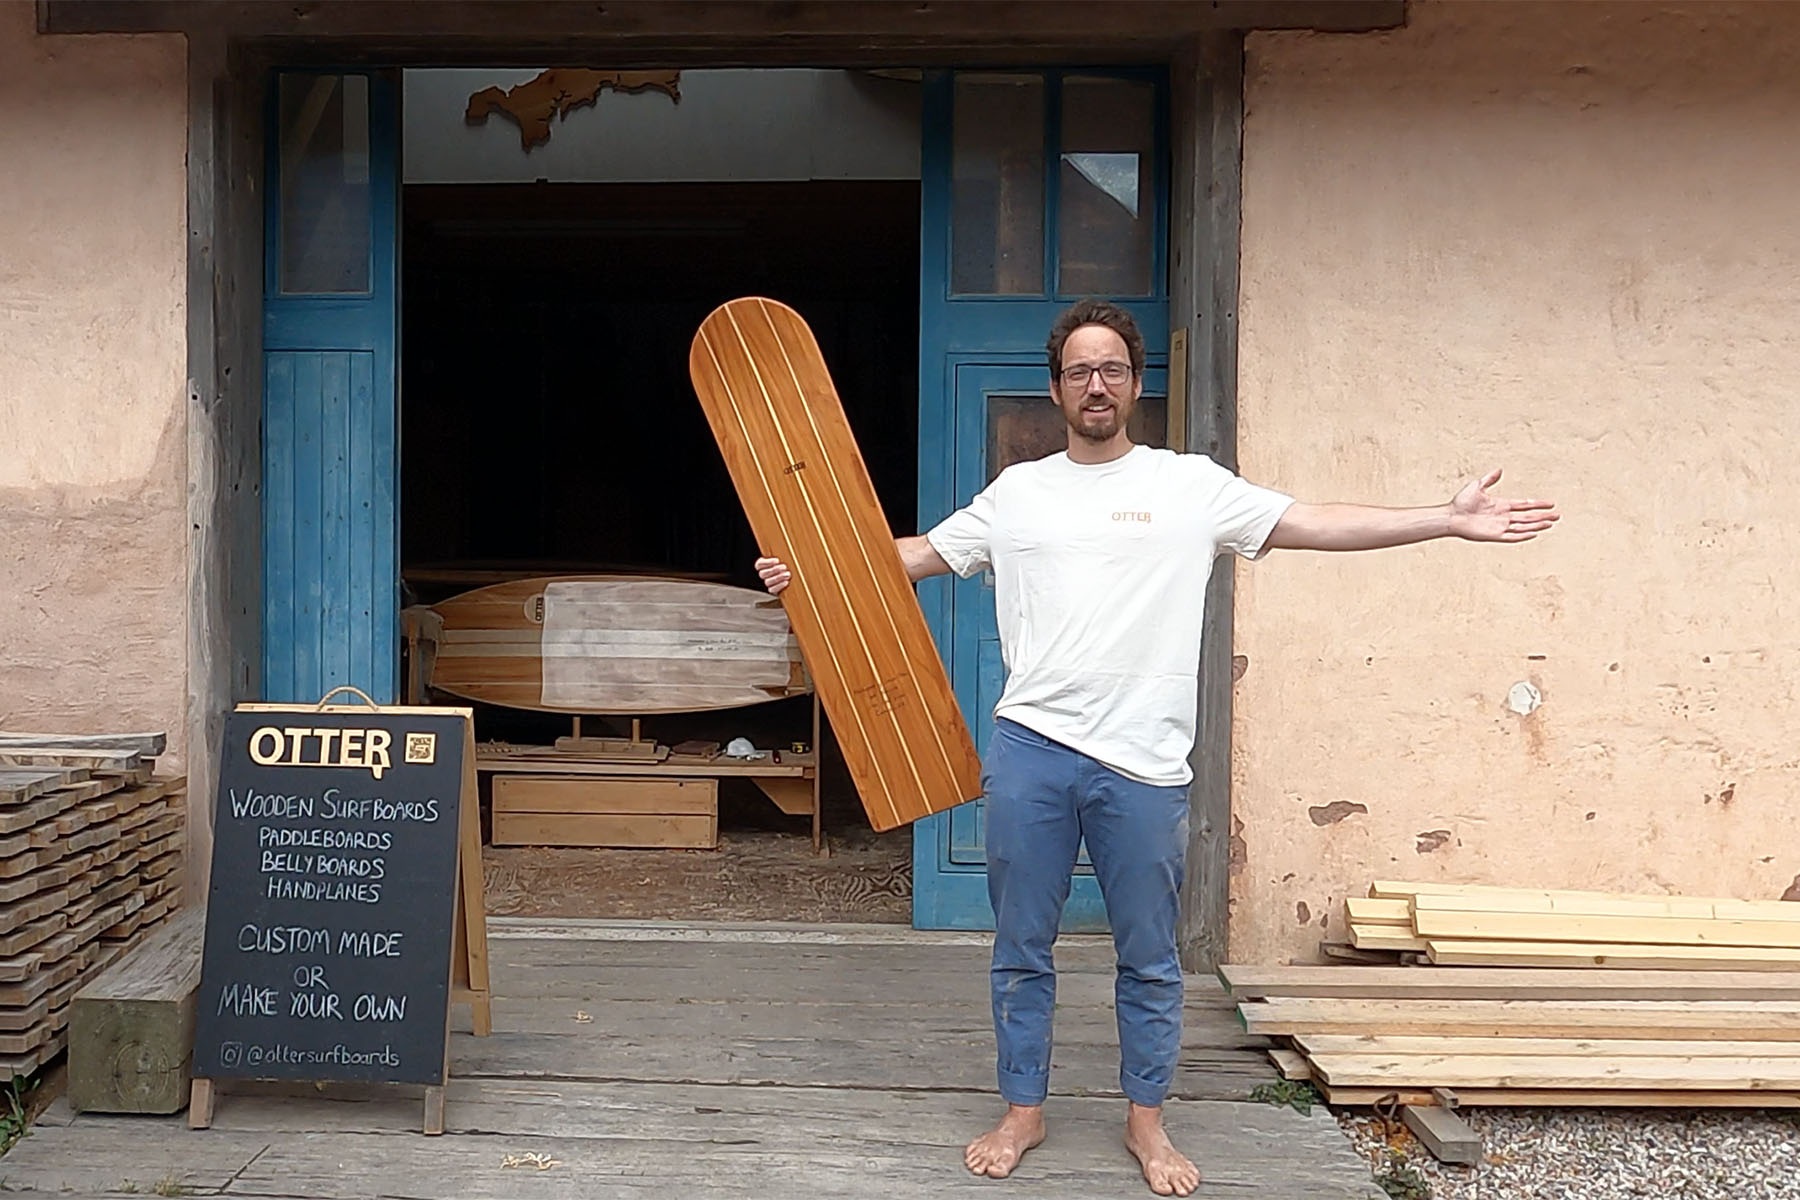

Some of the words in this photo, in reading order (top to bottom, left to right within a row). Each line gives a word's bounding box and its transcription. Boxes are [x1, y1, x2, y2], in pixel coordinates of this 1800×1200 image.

[1111, 511, 1152, 524] OTTER
[249, 727, 392, 779] OTTER
[230, 789, 313, 818] WOODEN
[320, 788, 438, 822] SURFBOARDS
[259, 827, 392, 850] PADDLEBOARDS
[261, 850, 385, 879] BELLYBOARDS
[267, 877, 382, 903] HANDPLANES
[238, 924, 330, 955] CUSTOM
[338, 929, 403, 957] MADE
[293, 966, 329, 990] OR
[217, 984, 279, 1016] MAKE
[290, 992, 343, 1020] YOUR
[354, 995, 406, 1021] OWN
[247, 1044, 400, 1067] @ottersurfboards
